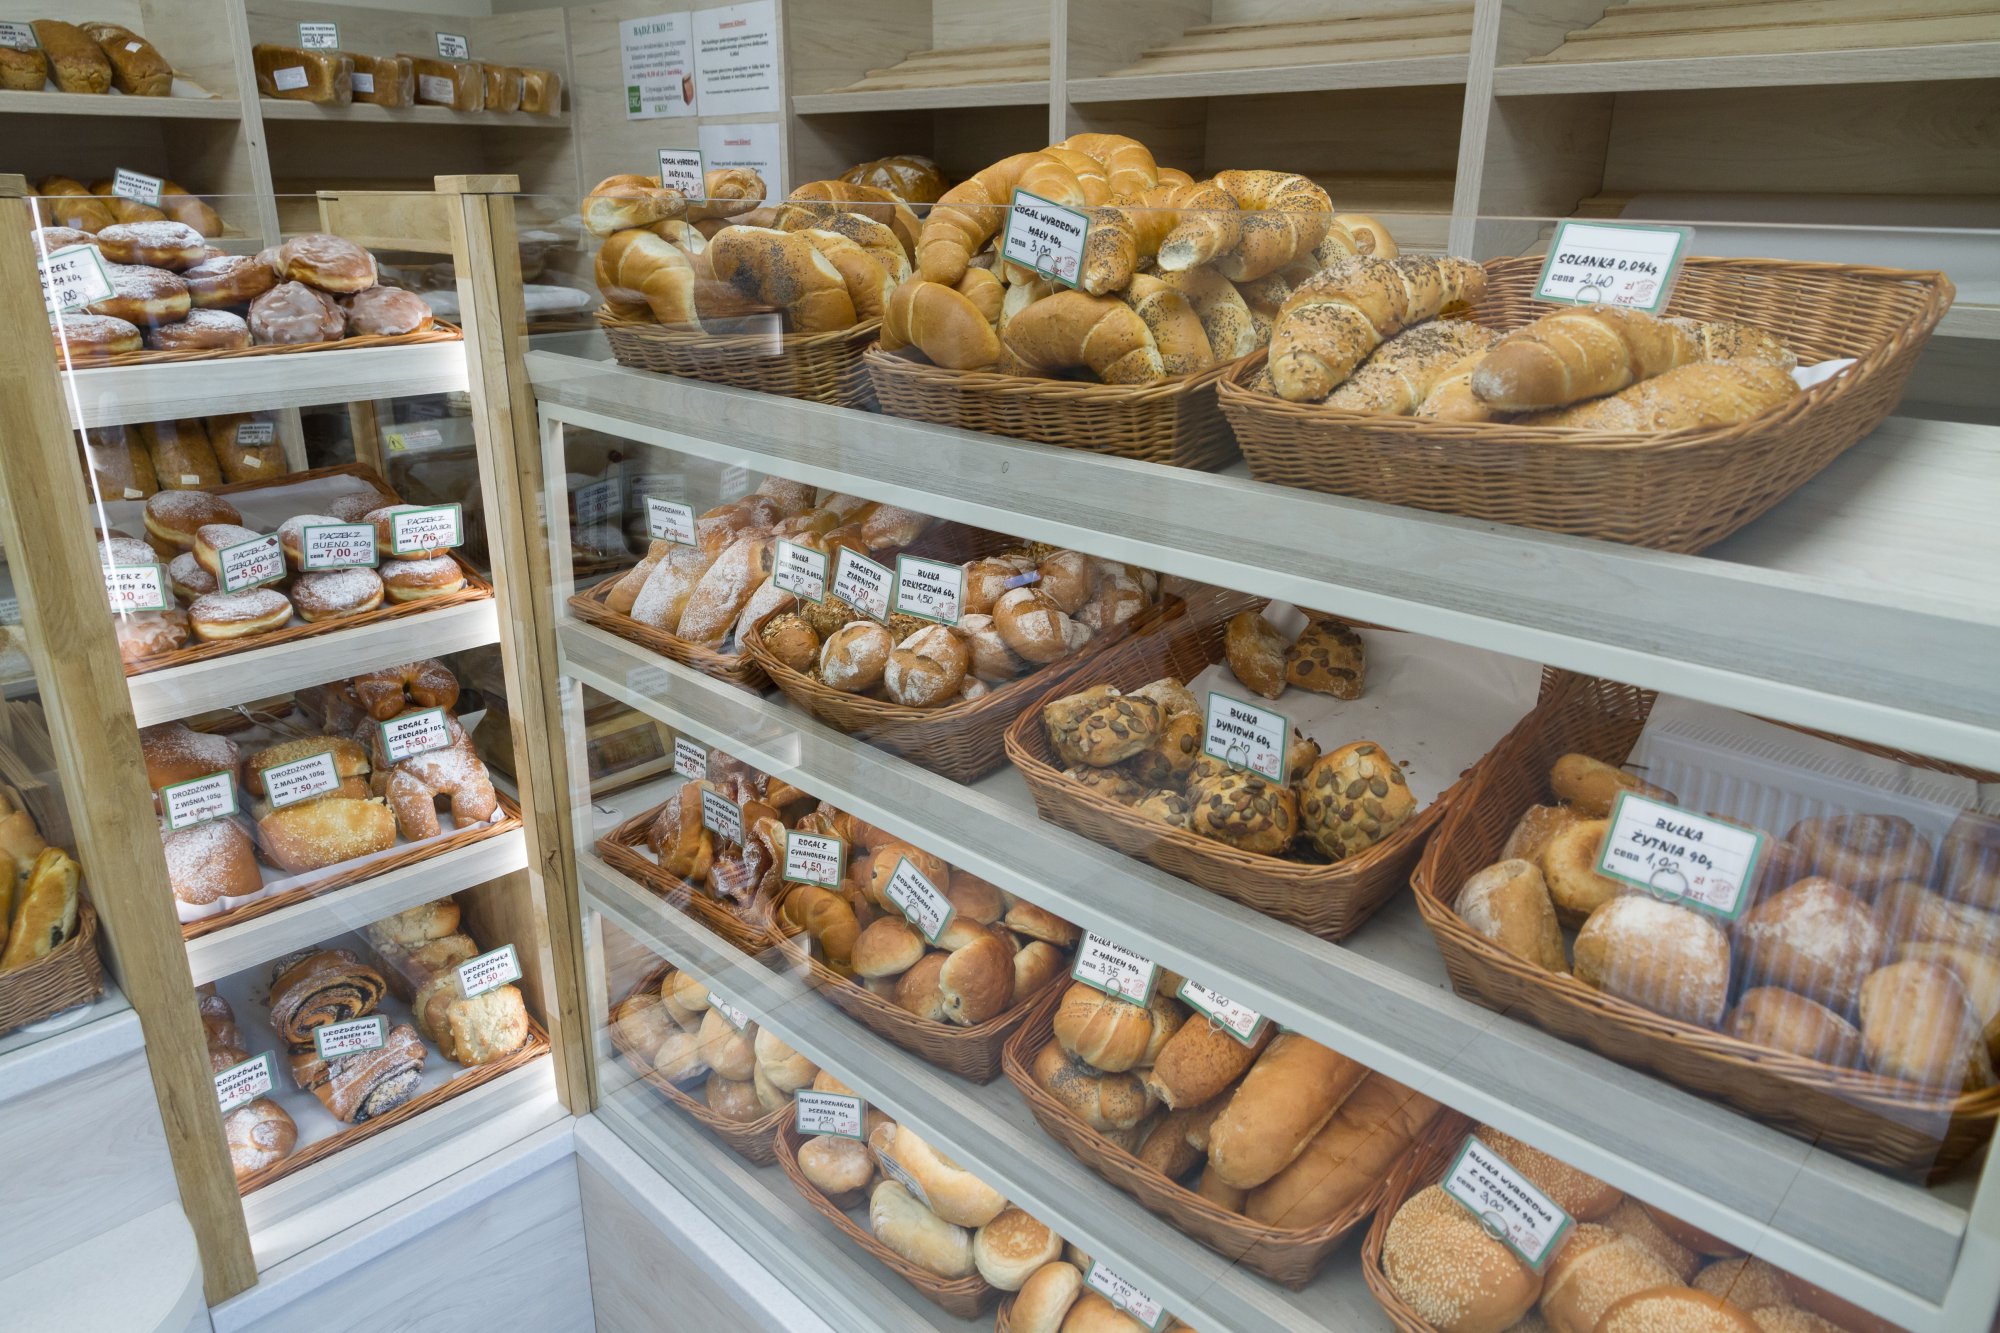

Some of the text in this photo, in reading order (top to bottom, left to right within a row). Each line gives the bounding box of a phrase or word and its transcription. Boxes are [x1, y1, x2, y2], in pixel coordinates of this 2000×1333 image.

[652, 24, 666, 34] EKO
[662, 157, 676, 165] ROGAL
[1014, 203, 1081, 237] ROGAL WYBOROWY
[1028, 226, 1049, 241] MAŁY
[1010, 237, 1026, 248] cena
[1558, 253, 1615, 269] SOLANKA
[1551, 273, 1575, 283] cena
[652, 504, 687, 517] JAGODZIANKA
[312, 540, 371, 549] BUENO 80g
[325, 548, 351, 559] 7,00
[241, 564, 263, 579] 5,50
[850, 559, 882, 582] BAGIETKA
[917, 569, 940, 582] BUŁKA
[791, 573, 805, 585] 1,50
[846, 570, 879, 592] ZIARNISTA
[837, 581, 870, 601] cena 4,50
[902, 578, 956, 600] ORKISZOWA 60g
[901, 593, 914, 601] cena
[916, 593, 934, 605] 1,50
[1230, 707, 1258, 725] BUŁKA
[397, 718, 431, 732] ROGAL Z
[1210, 735, 1226, 746] cena
[1216, 718, 1271, 750] DYNIOWA 60g
[405, 735, 428, 749] 5,50
[270, 760, 324, 781] DROŻDŻÓWKA
[683, 760, 697, 773] 4,50
[309, 769, 326, 780] 105g
[172, 782, 221, 800] DROŻDŻÓWKA
[206, 793, 222, 802] 105g
[274, 791, 289, 799] cena
[292, 783, 312, 795] 7,50
[1655, 817, 1704, 842] BUŁKA
[797, 838, 828, 850] ROGAL Z
[1631, 829, 1686, 857] ŻYTNIA
[790, 848, 827, 860] CYNAMONEM
[1613, 847, 1640, 862] cena
[801, 860, 822, 872] 4,50
[896, 873, 931, 911] RODZYNKAMI
[911, 874, 935, 901] BUŁKA Z
[1088, 933, 1111, 948] BUŁKA
[463, 952, 509, 976] DROŻDŻÓWKA
[1082, 960, 1097, 970] cena
[1092, 949, 1099, 957] Z
[1099, 951, 1127, 968] MAKIEM
[472, 966, 496, 979] SEREM
[478, 972, 498, 986] 4,50
[1190, 980, 1206, 993] cena
[322, 1022, 377, 1038] DROŻDŻÓWKA
[333, 1032, 361, 1042] MAKIEM
[338, 1037, 362, 1048] 4,50
[228, 1083, 252, 1099] 4,50
[820, 1099, 855, 1109] POZNAŃSKA
[808, 1107, 836, 1116] PSZENNA
[1456, 1176, 1476, 1193] cena
[1469, 1150, 1553, 1222] BUŁKA WYBOROWA
[1469, 1169, 1478, 1177] Z
[1479, 1175, 1521, 1213] SEZAMEM
[1094, 1271, 1109, 1284] cena
